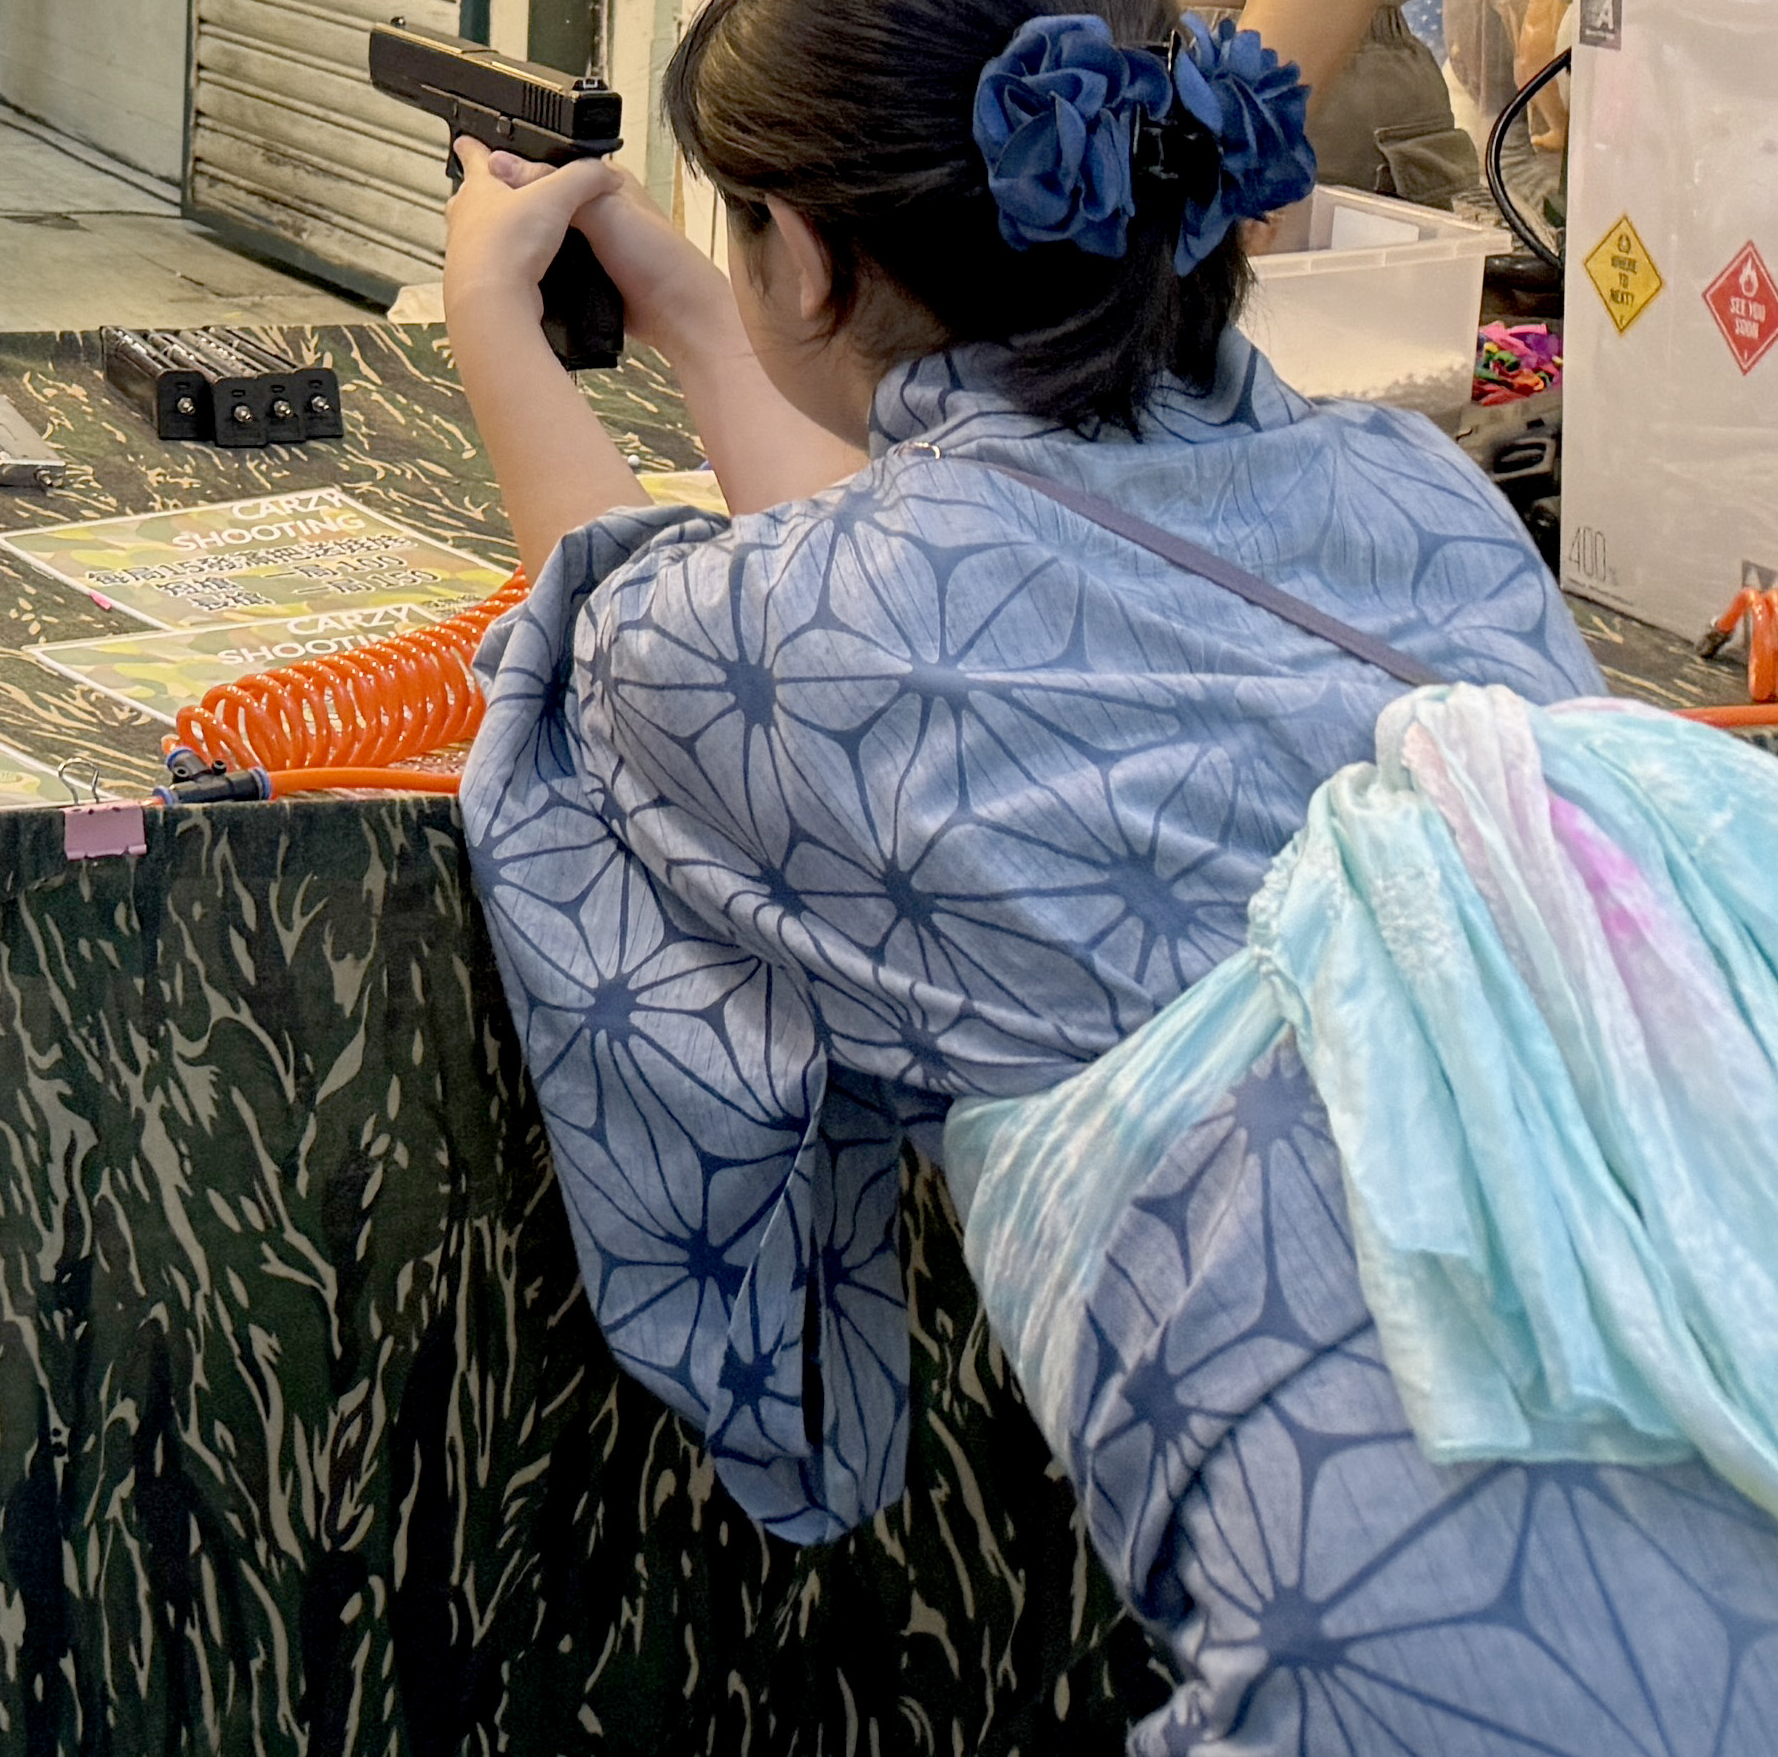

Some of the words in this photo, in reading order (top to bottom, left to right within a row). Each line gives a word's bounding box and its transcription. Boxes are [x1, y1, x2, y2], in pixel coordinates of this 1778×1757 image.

[232, 490, 343, 520] CARZY
[172, 512, 366, 551] SHOOTING
[1568, 526, 1607, 582] 400
[286, 603, 415, 635] CARZY
[217, 630, 397, 666] SHOOTI
